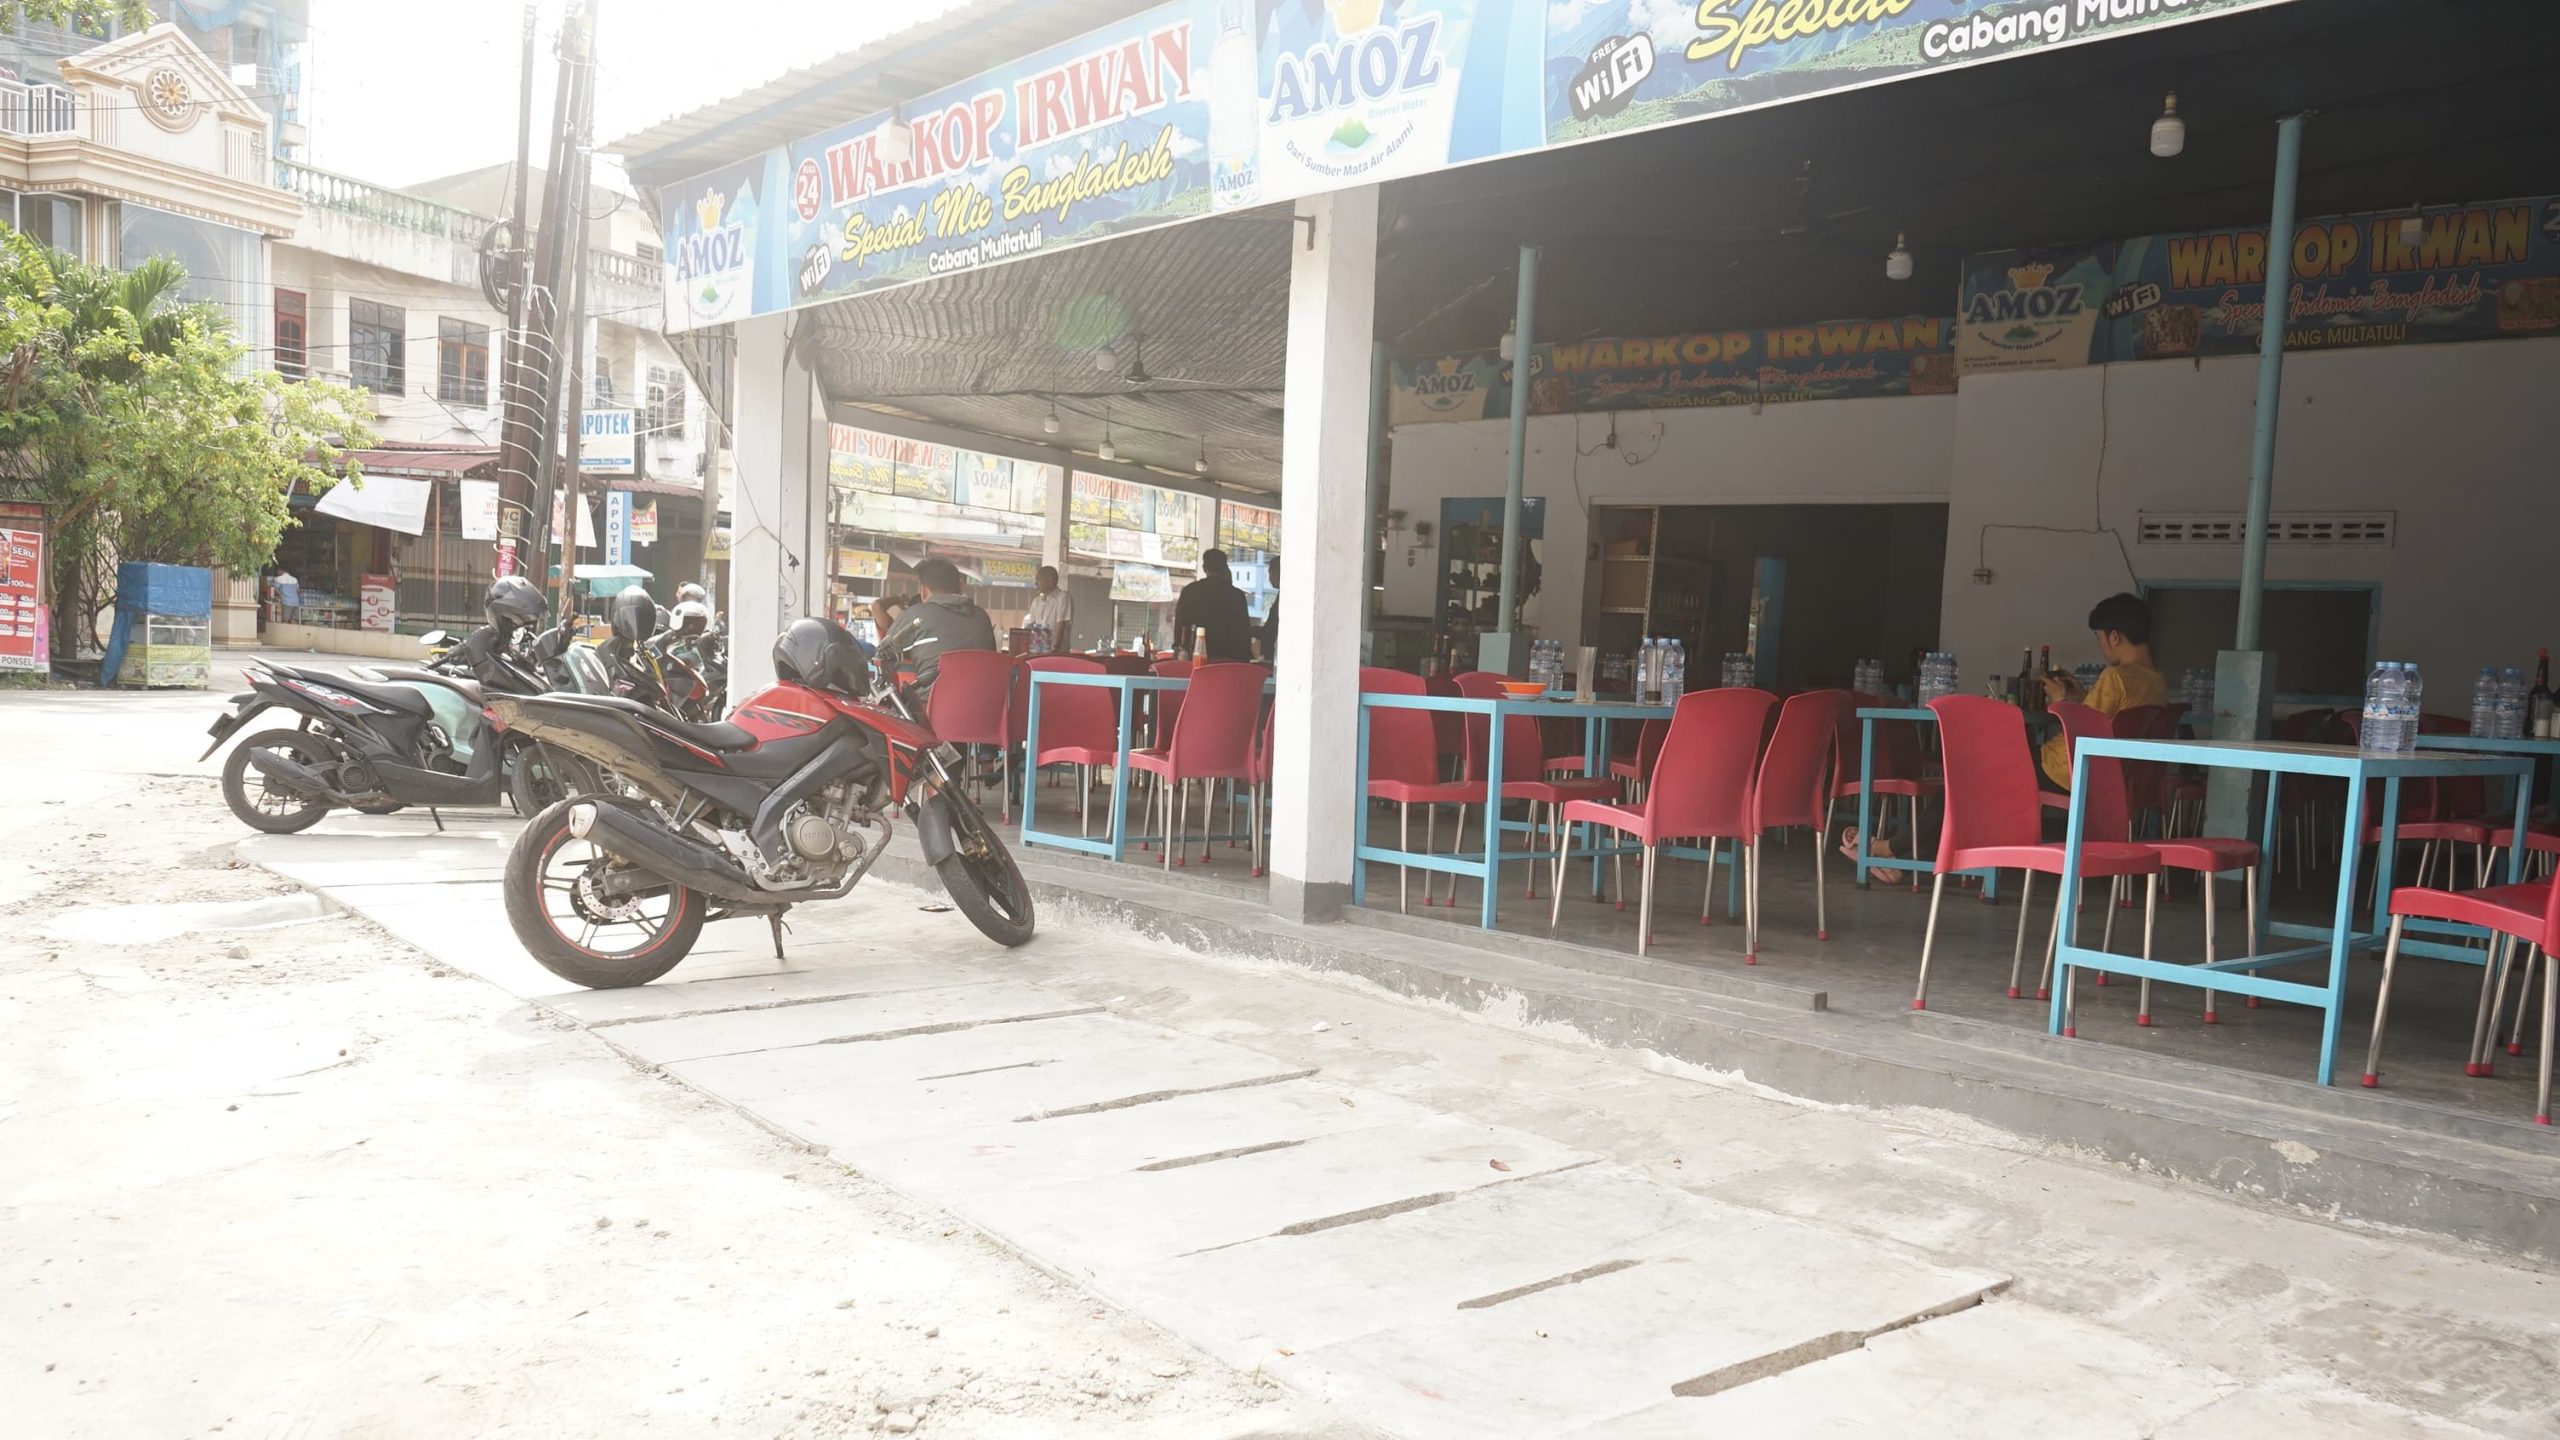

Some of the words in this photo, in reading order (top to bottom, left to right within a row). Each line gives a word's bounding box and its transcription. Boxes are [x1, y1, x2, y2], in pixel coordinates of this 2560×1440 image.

[1592, 37, 1619, 63] FREE
[1923, 9, 2065, 58] Cabang
[1015, 24, 1192, 149] IRWAN
[1269, 20, 1440, 122] AMOZ
[1575, 45, 1649, 110] WiFi
[1286, 140, 1306, 162] Dari
[1305, 157, 1341, 177] Sumber
[1343, 163, 1369, 177] Mata
[1370, 152, 1386, 168] Air
[1386, 121, 1414, 156] Alami
[798, 175, 819, 205] 24
[842, 204, 926, 268] Spesial
[934, 183, 993, 238] Mie
[1001, 124, 1174, 220] Bangladesh
[1218, 170, 1254, 192] AMOZ
[675, 227, 744, 282] AMOZ
[928, 244, 978, 273] Cabang
[980, 225, 1042, 264] Multatuli
[2168, 223, 2360, 290] WAROP
[1967, 284, 2084, 323] AMOZ
[2106, 287, 2158, 316] WiFi
[2289, 284, 2367, 320] Indomie
[2370, 272, 2482, 320] Bangladesh
[1550, 333, 1752, 374] WARKOP
[1766, 318, 1940, 361] IRWAN
[2328, 323, 2406, 344] MULTATULI
[1415, 372, 1475, 396] AMOZ
[1757, 358, 1877, 389] Bangladesh
[12, 546, 35, 559] SERU
[1, 656, 32, 666] PONSEL
